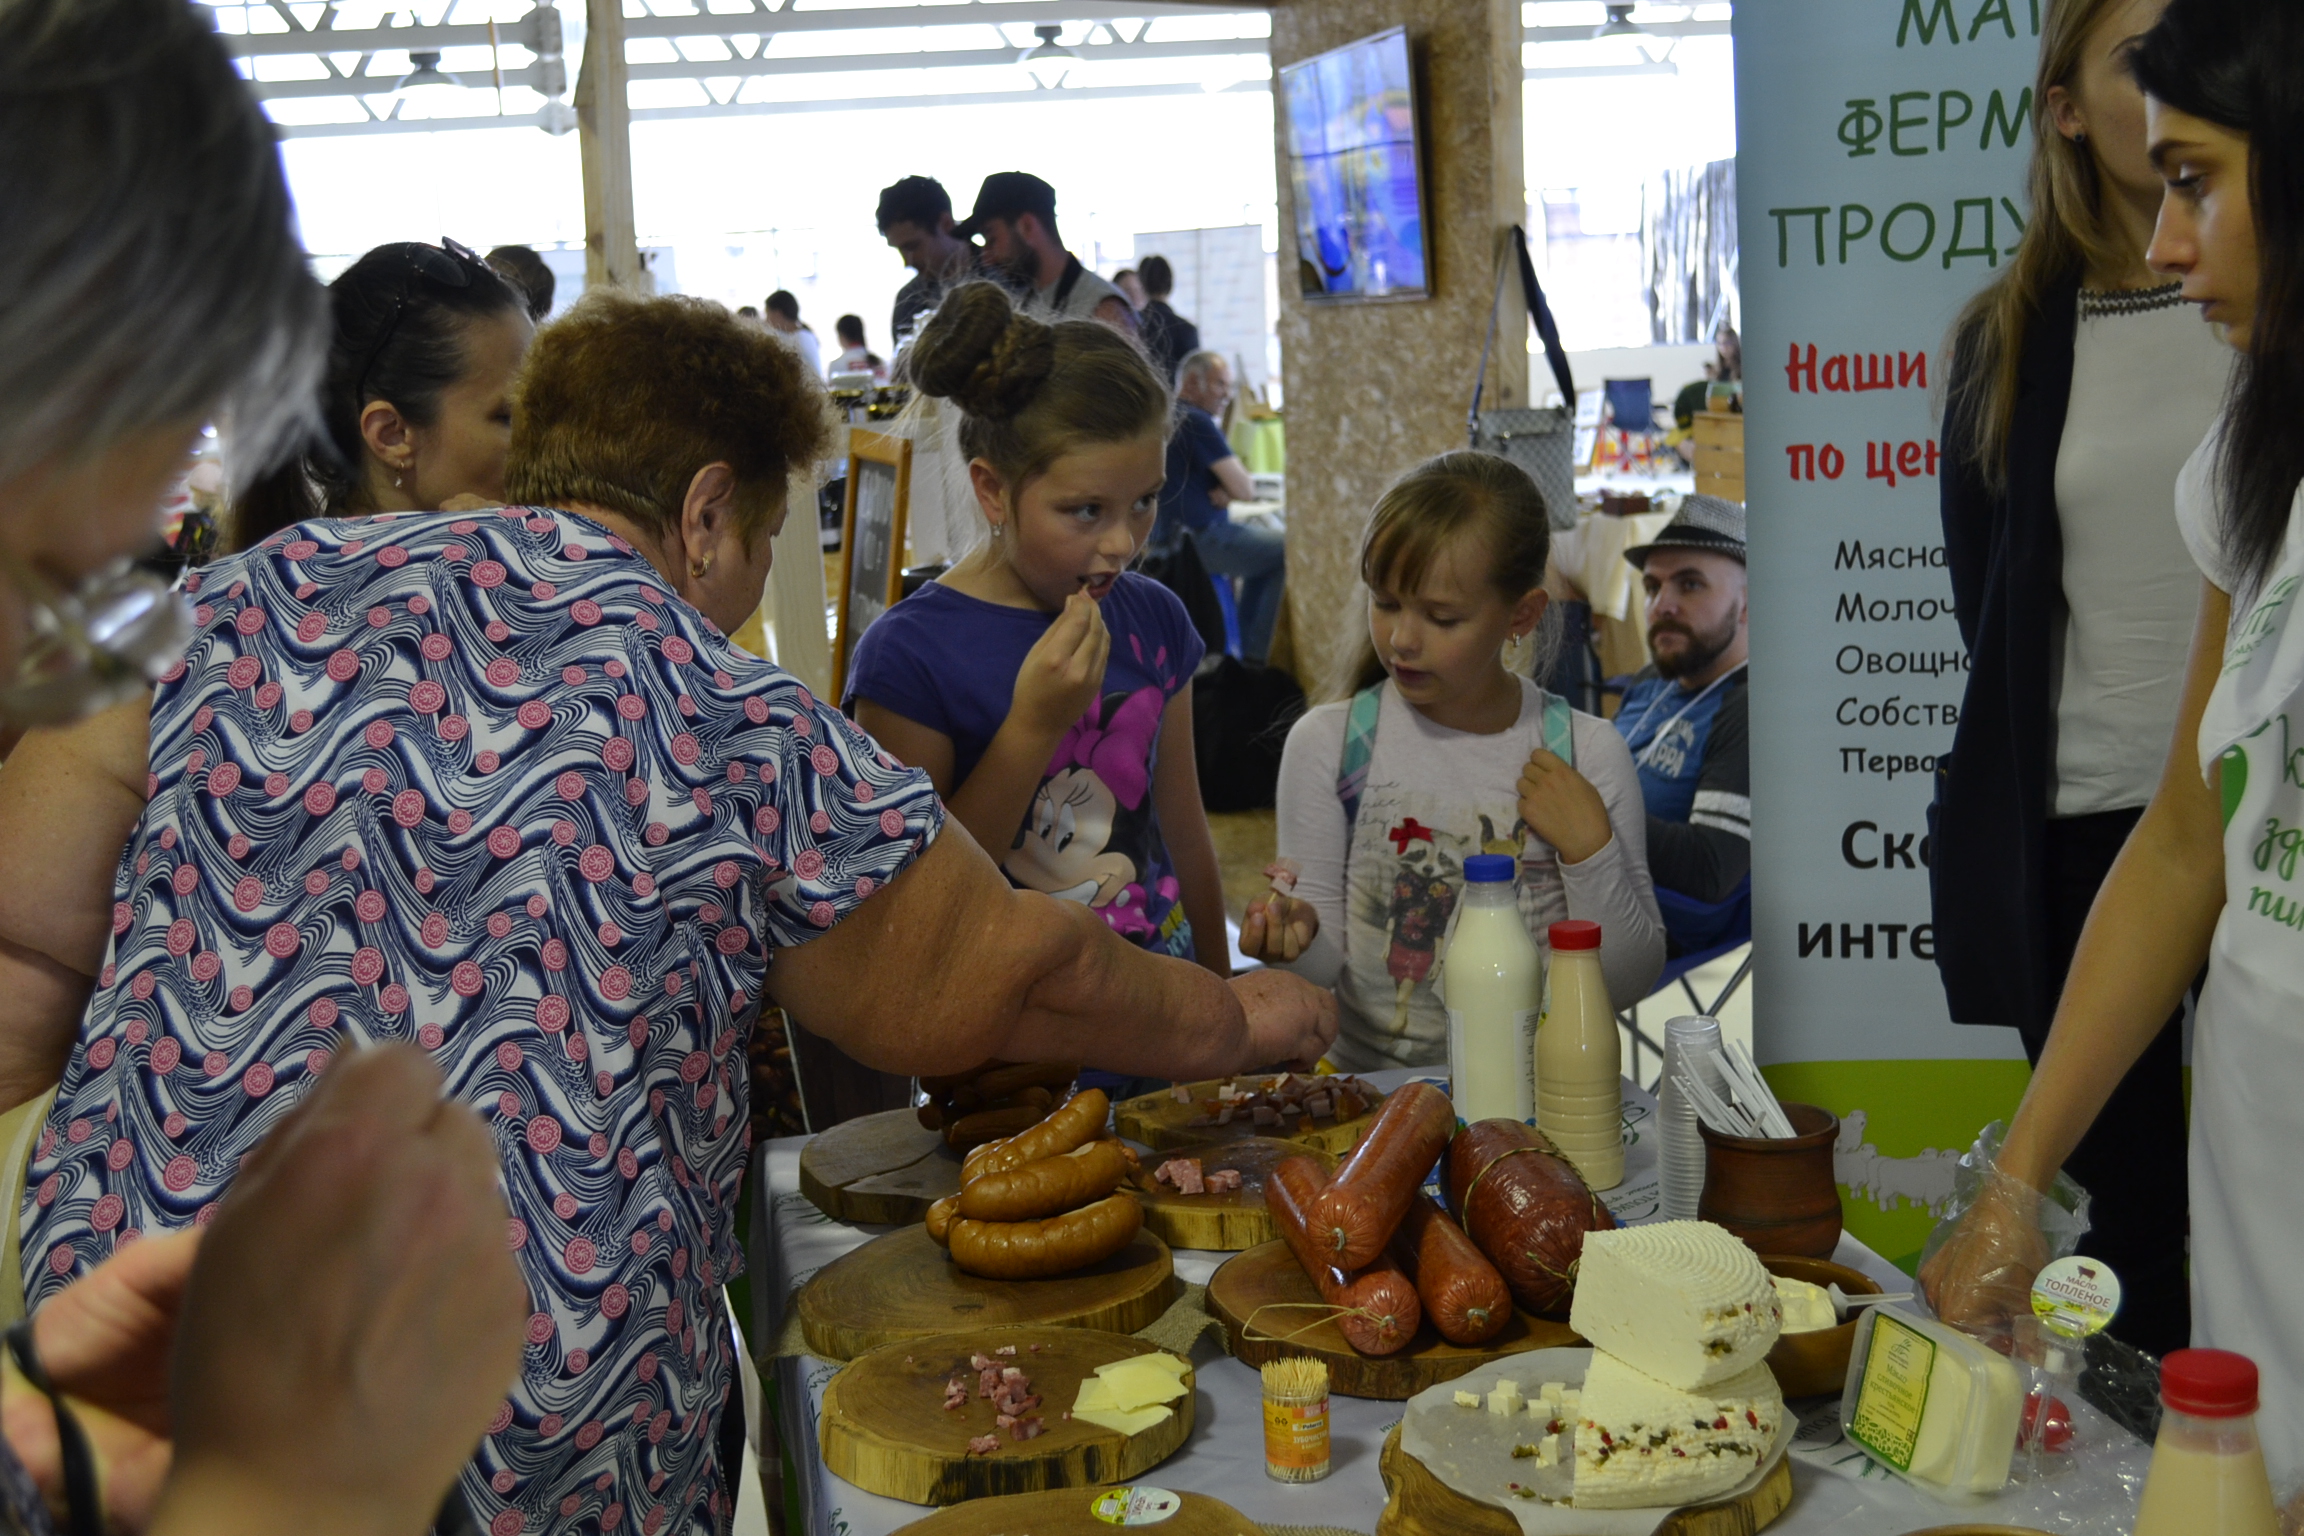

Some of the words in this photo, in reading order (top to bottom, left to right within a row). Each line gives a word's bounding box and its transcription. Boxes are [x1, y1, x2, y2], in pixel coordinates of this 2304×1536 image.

[1784, 342, 1928, 394] Наши
[1785, 441, 1845, 481] по
[1834, 539, 1948, 571] Мясна
[1835, 696, 1959, 727] Собств
[1798, 922, 1936, 960] инте
[2044, 1277, 2111, 1308] ТОПЛЕНОЕ
[2065, 1275, 2098, 1292] МАСЛО
